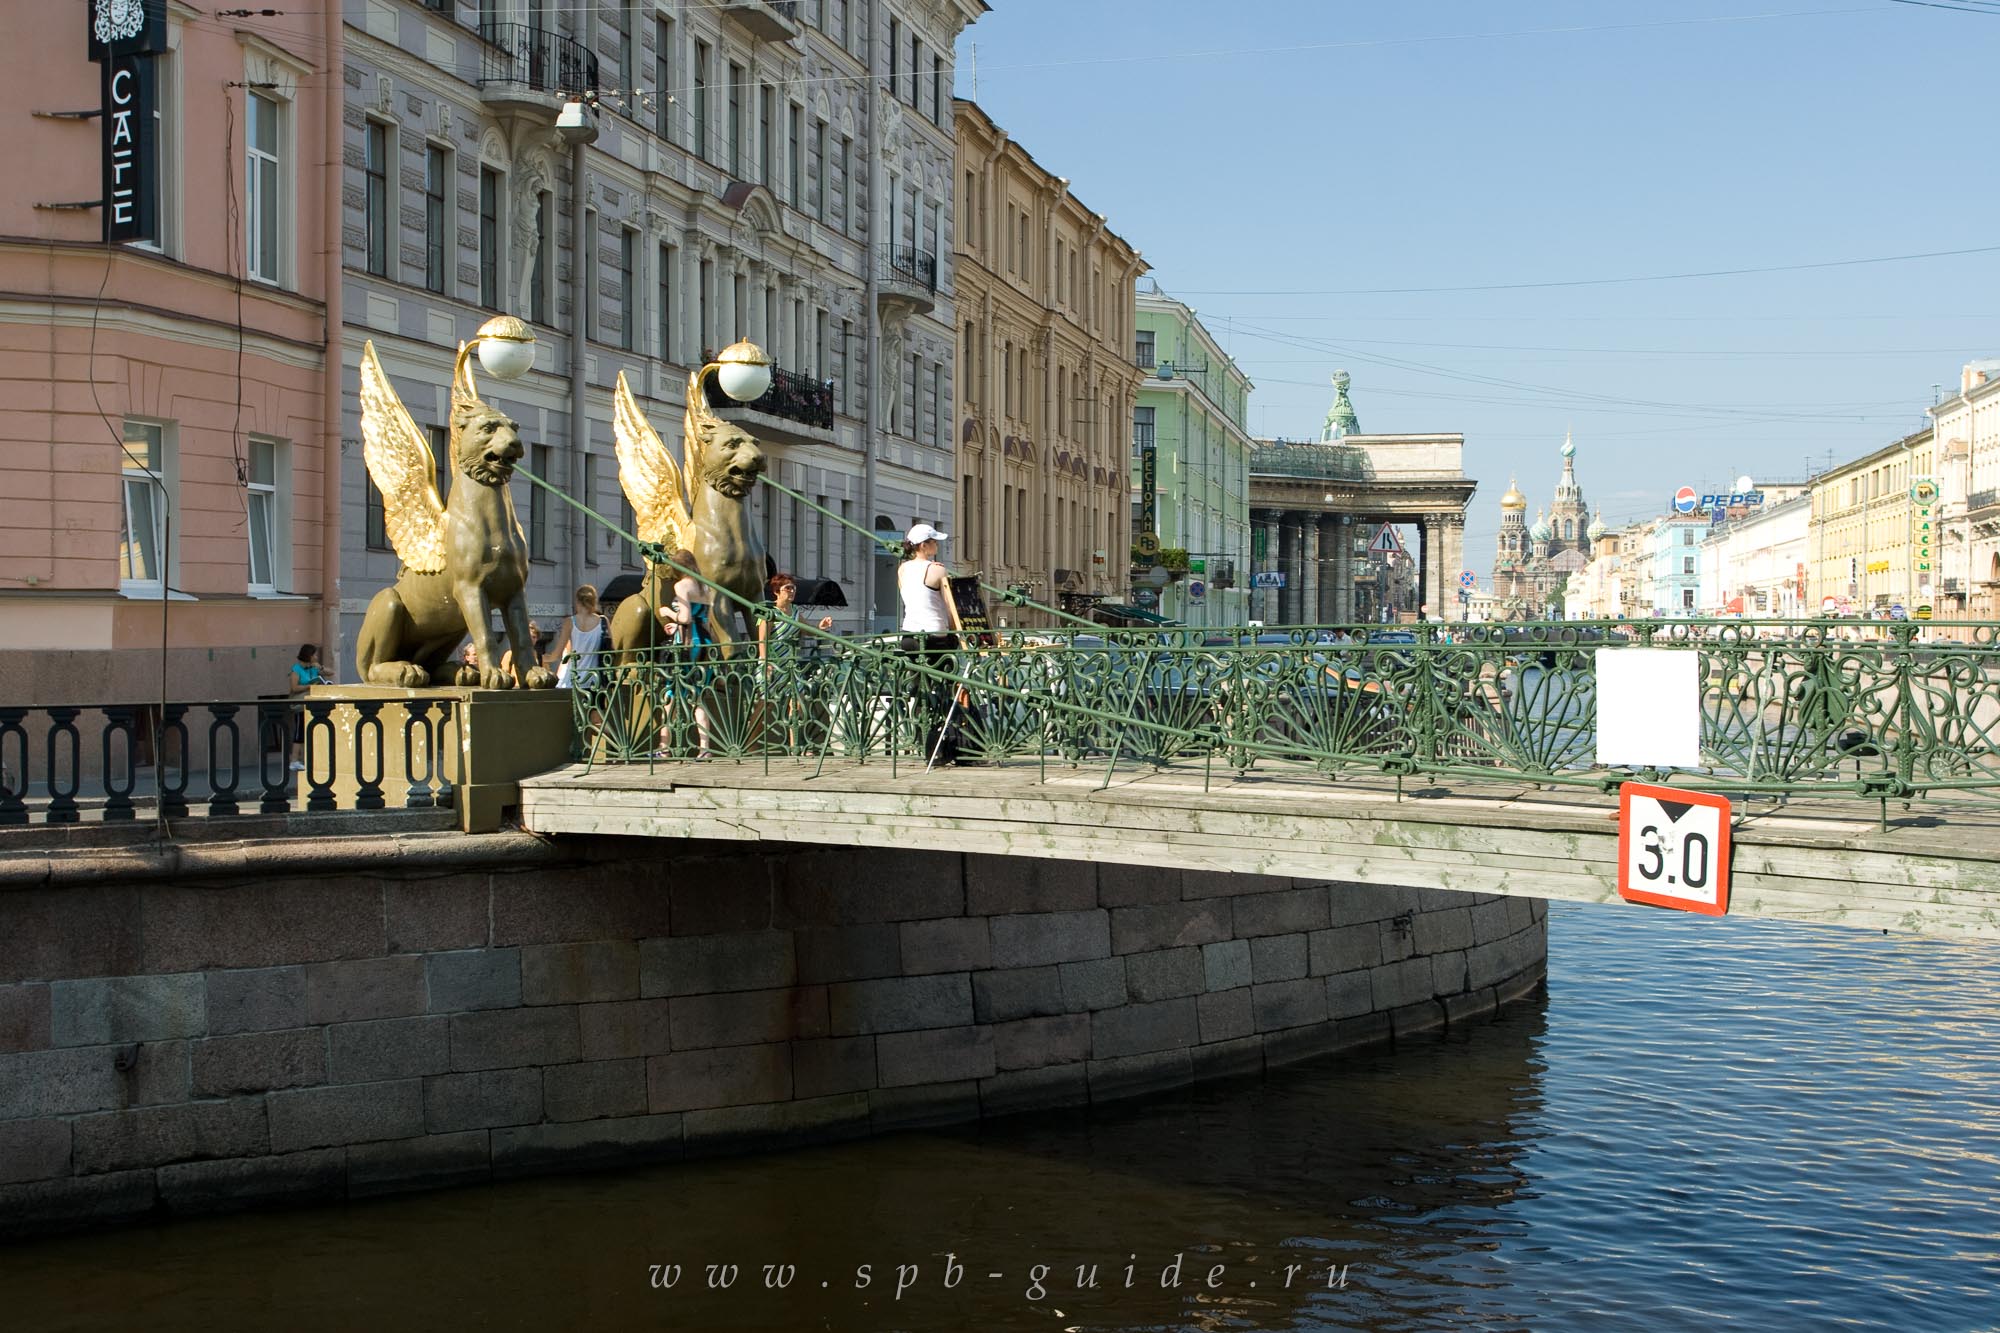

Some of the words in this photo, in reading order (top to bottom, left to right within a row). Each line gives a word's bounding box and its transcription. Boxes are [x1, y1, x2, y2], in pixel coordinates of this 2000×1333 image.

[112, 69, 133, 224] CAFE
[1144, 452, 1153, 531] РЕСТОРАН
[1700, 494, 1765, 507] PEPSI
[1919, 509, 1930, 570] КАССЫ
[1638, 825, 1708, 888] 3.0
